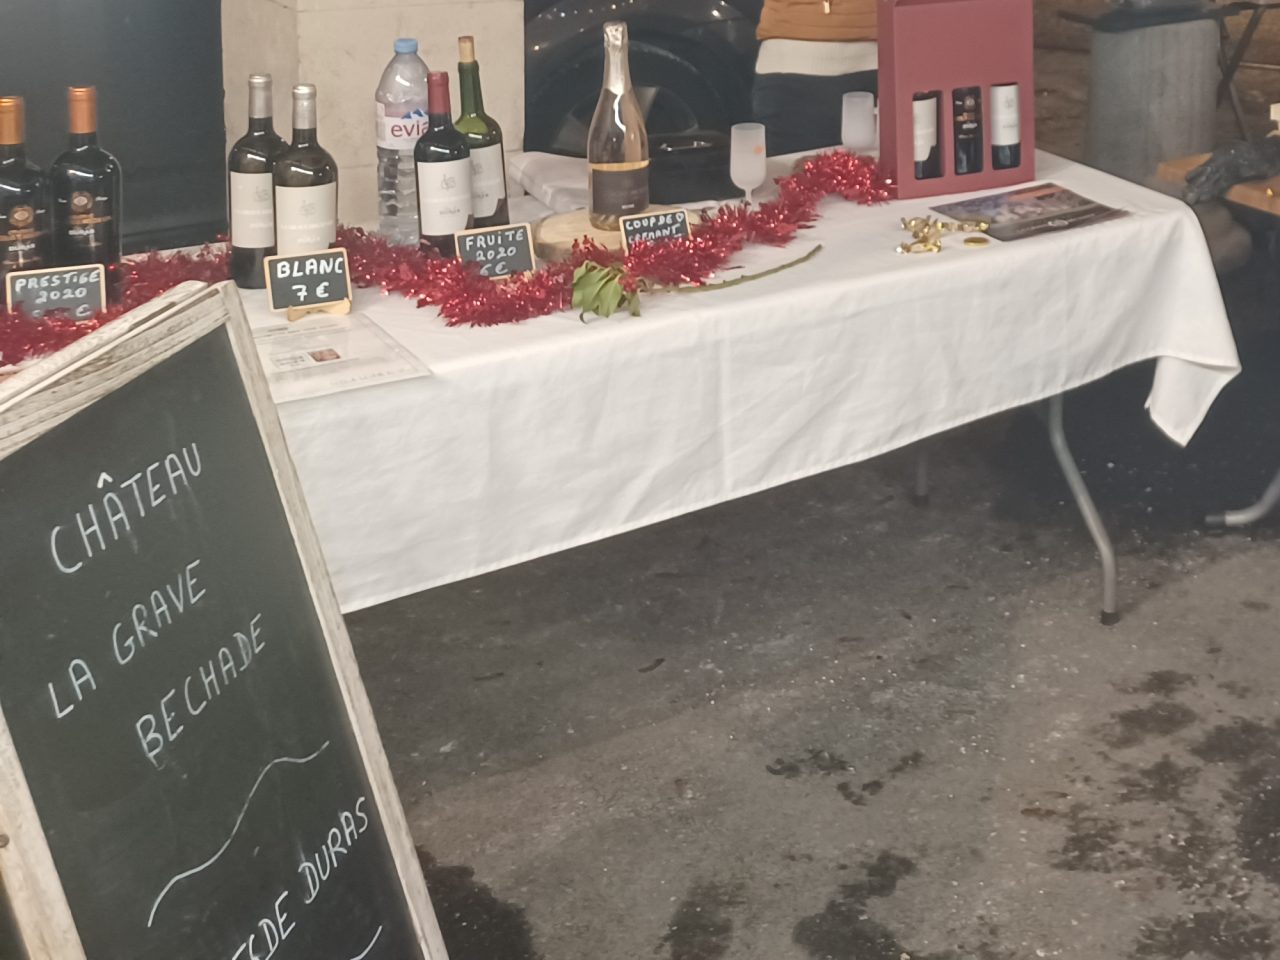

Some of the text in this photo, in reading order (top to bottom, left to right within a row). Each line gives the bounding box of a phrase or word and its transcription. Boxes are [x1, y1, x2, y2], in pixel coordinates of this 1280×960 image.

[391, 120, 429, 138] evia
[276, 257, 344, 279] BLANC
[476, 246, 517, 261] 2020
[35, 287, 87, 304] 2020
[50, 442, 202, 574] CHÂTEAU
[48, 559, 206, 719] LA GRAVE
[135, 613, 266, 767] BECHADE
[298, 796, 369, 904] DURAS
